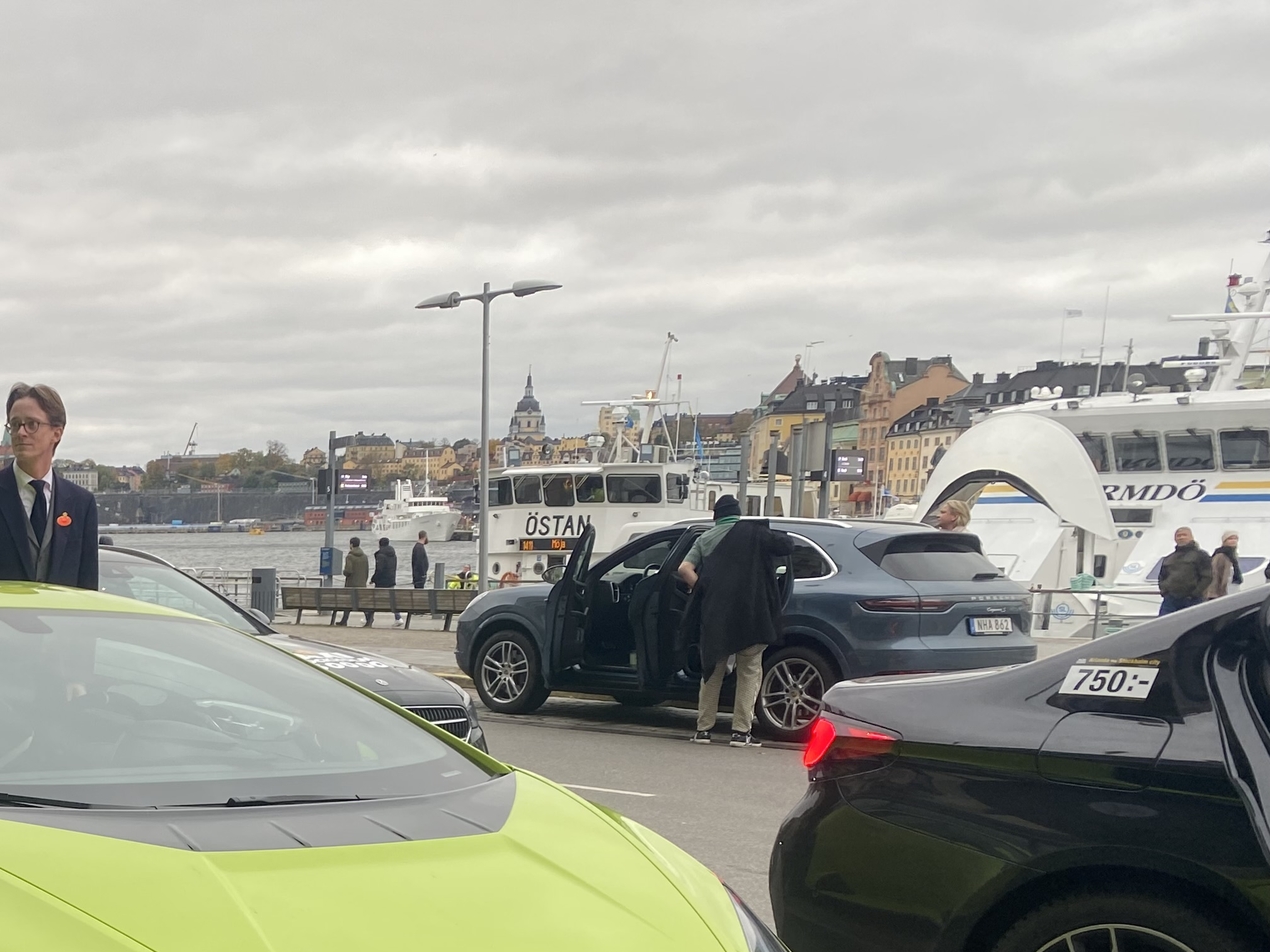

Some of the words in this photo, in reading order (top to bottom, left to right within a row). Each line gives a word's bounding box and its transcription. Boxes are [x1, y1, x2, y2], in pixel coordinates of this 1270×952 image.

[526, 512, 591, 535] ÖSTAN
[977, 619, 993, 630] NHA
[995, 619, 1009, 630] 862
[1073, 669, 1149, 692] 750:-
